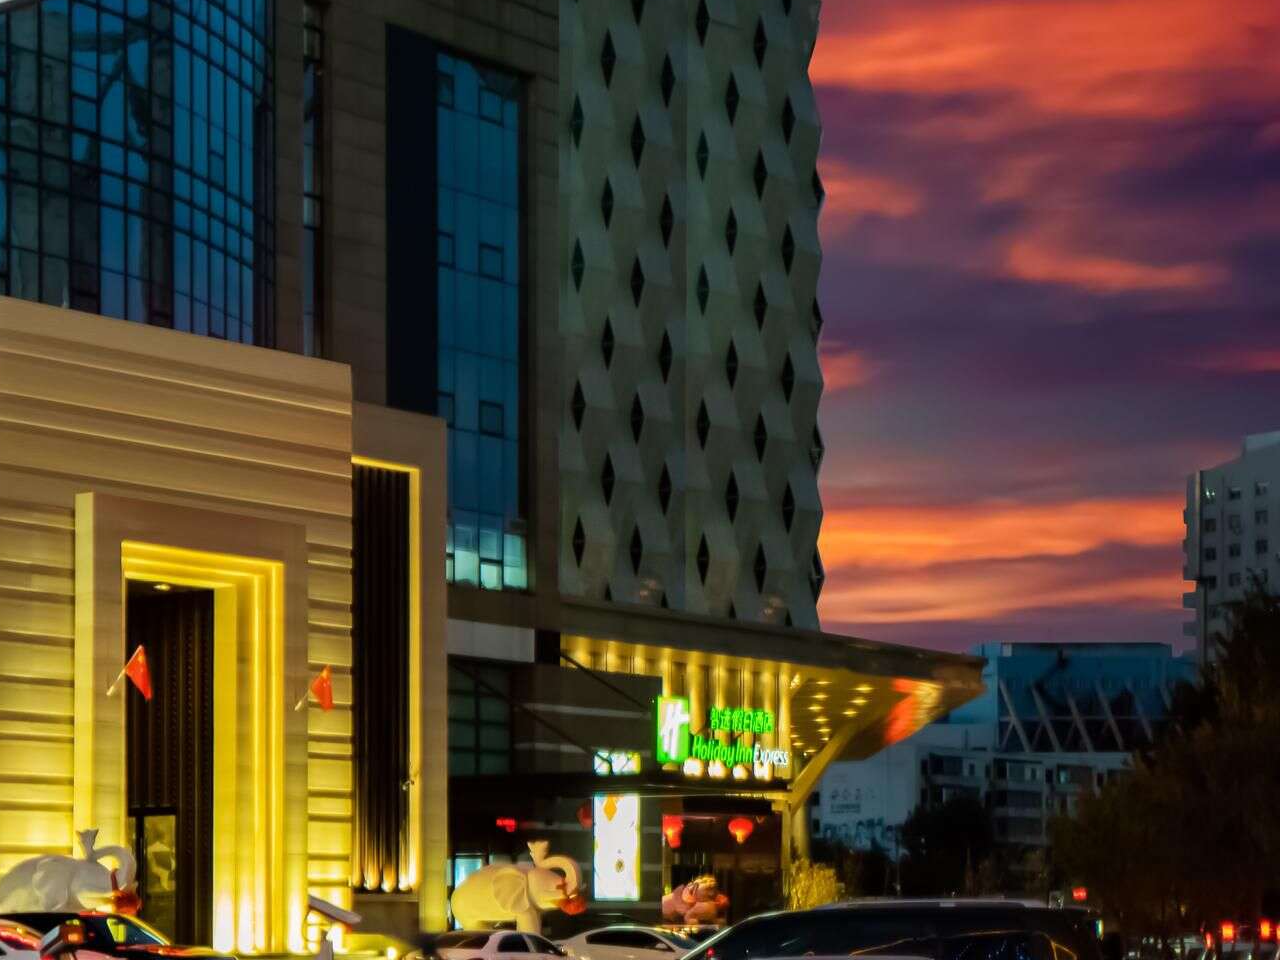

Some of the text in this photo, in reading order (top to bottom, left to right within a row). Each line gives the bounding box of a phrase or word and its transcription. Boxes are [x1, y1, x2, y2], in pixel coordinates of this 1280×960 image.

[710, 705, 775, 734] 智选假日酒店
[692, 735, 788, 768] Holiday Inn Express
